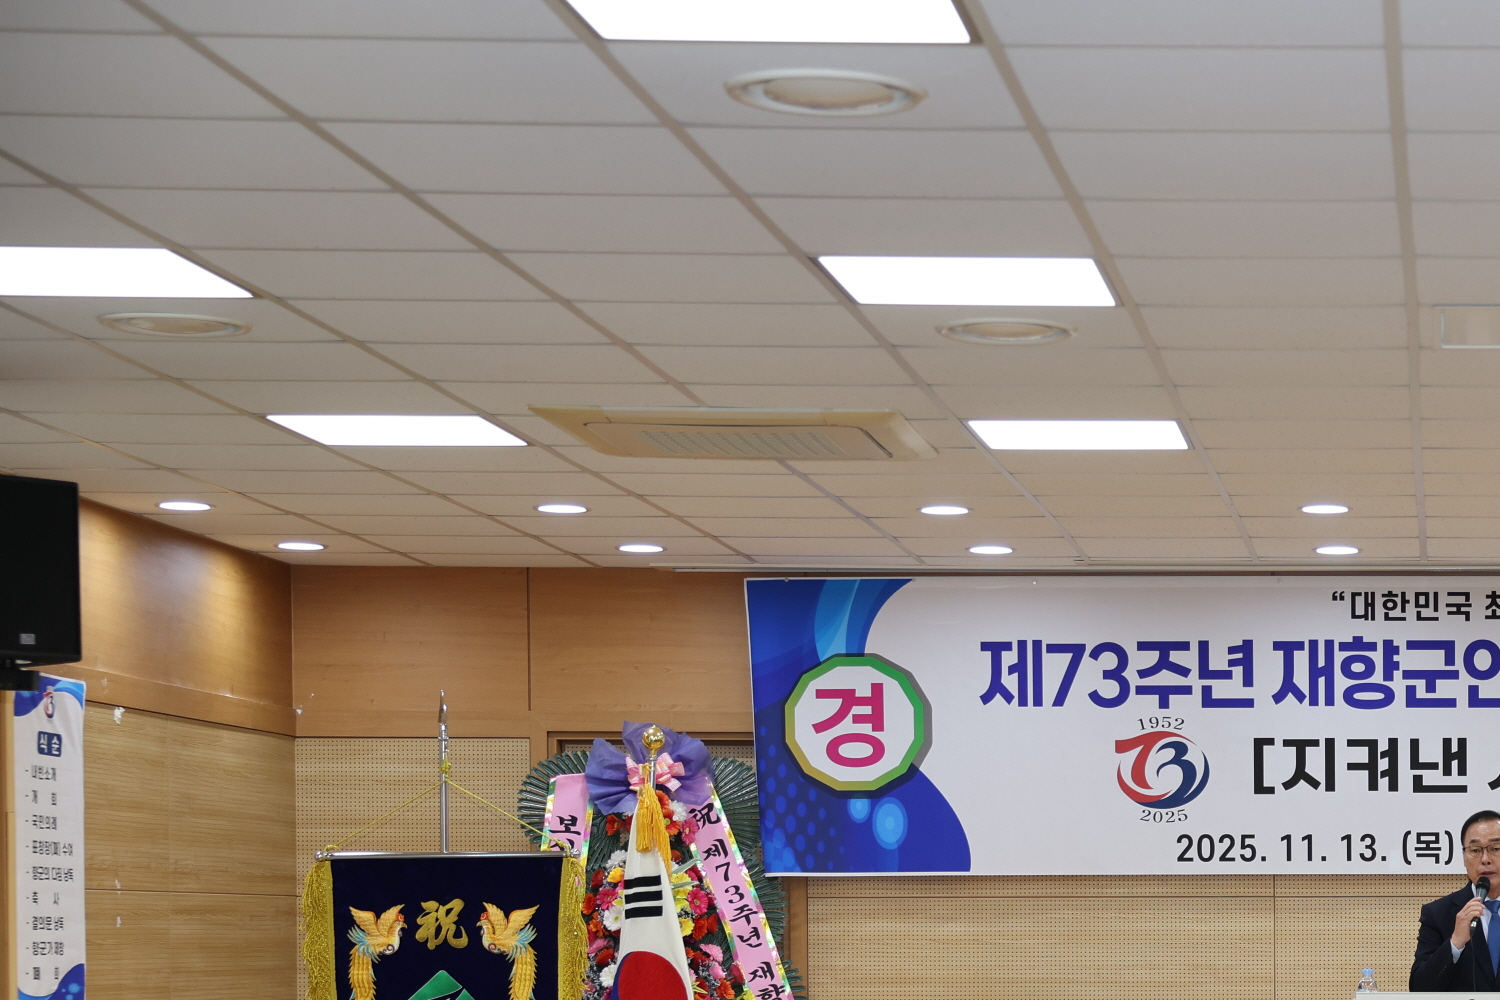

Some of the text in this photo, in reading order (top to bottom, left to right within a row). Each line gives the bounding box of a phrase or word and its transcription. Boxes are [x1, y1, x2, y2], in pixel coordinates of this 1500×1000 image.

[1332, 591, 1473, 622] “대한민국
[980, 637, 1255, 710] 제73주년
[812, 683, 886, 768] 경
[1137, 716, 1185, 731] 1952
[1254, 738, 1468, 795] [지켜낸
[689, 802, 722, 829] 祝
[1140, 809, 1188, 823] 2025
[1176, 833, 1267, 863] 2025.
[1281, 833, 1327, 862] 11.
[1340, 833, 1387, 862] 13.
[1402, 830, 1454, 866] (목)
[702, 838, 763, 948] 제73주년
[415, 898, 469, 951] 祝
